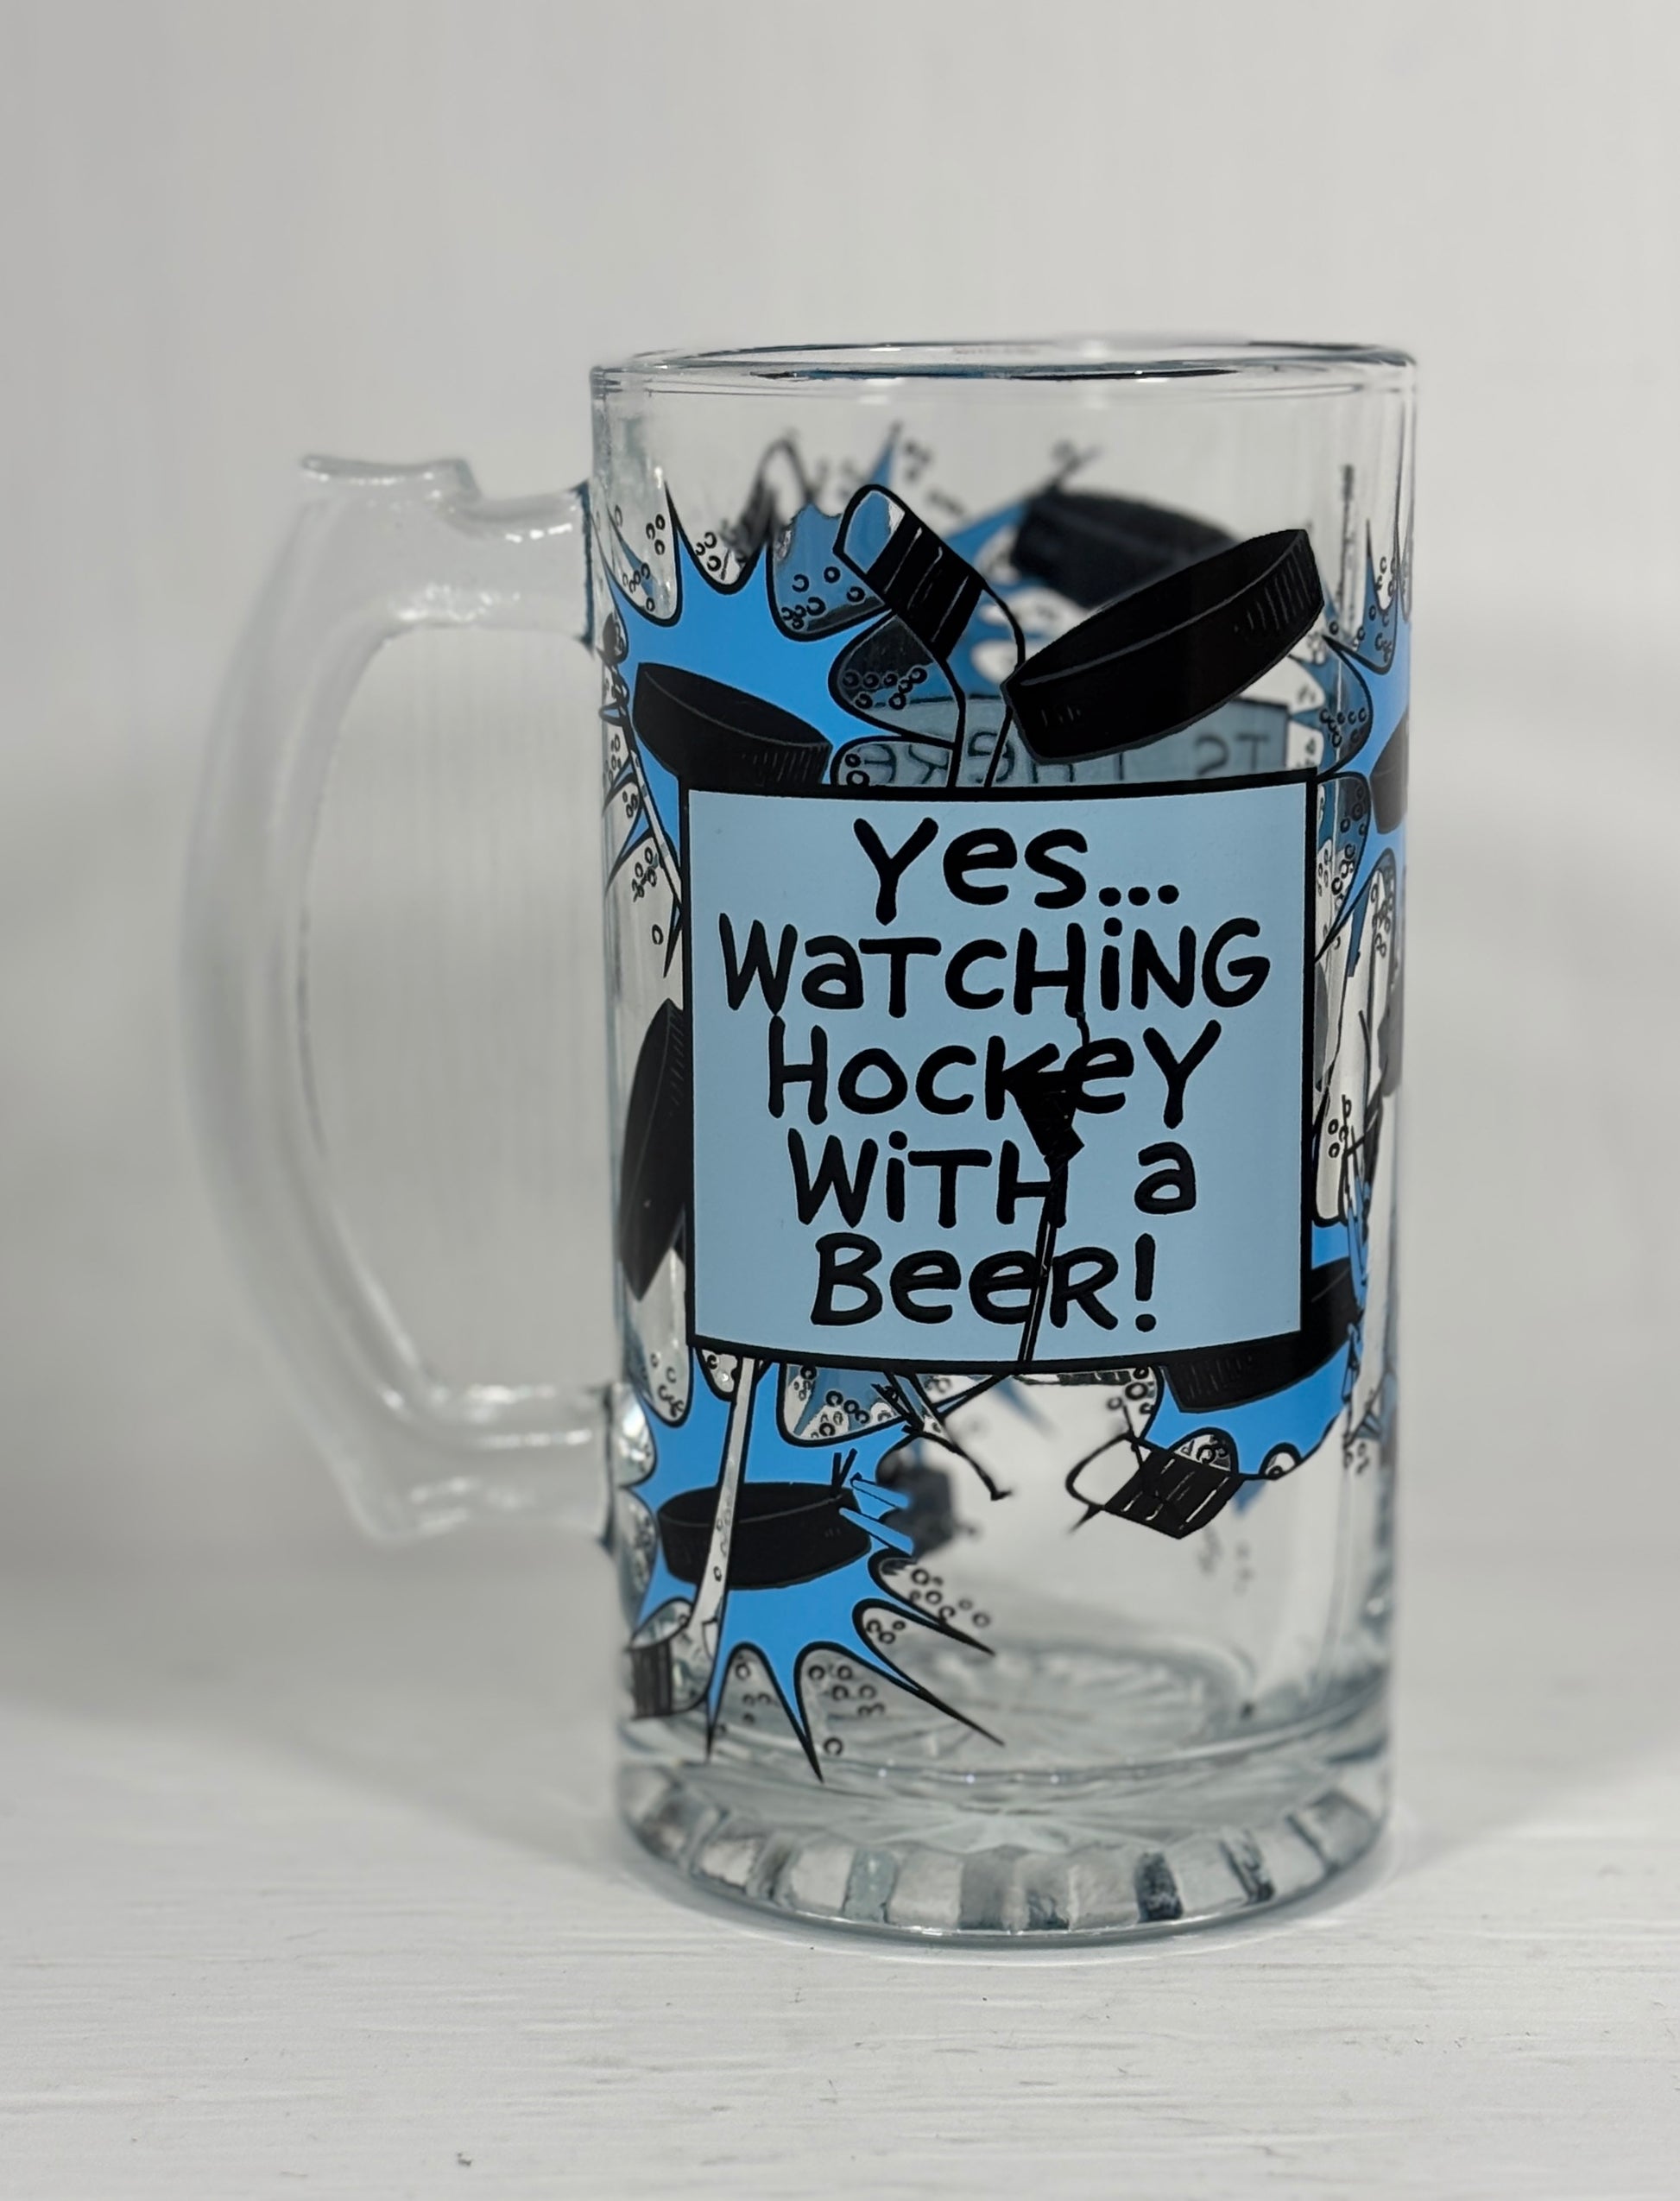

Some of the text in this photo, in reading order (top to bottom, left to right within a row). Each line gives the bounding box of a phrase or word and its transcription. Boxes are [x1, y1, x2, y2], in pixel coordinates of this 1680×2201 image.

[787, 1127, 1197, 1230] WiTH a
[809, 1230, 1158, 1334] BeeR!
